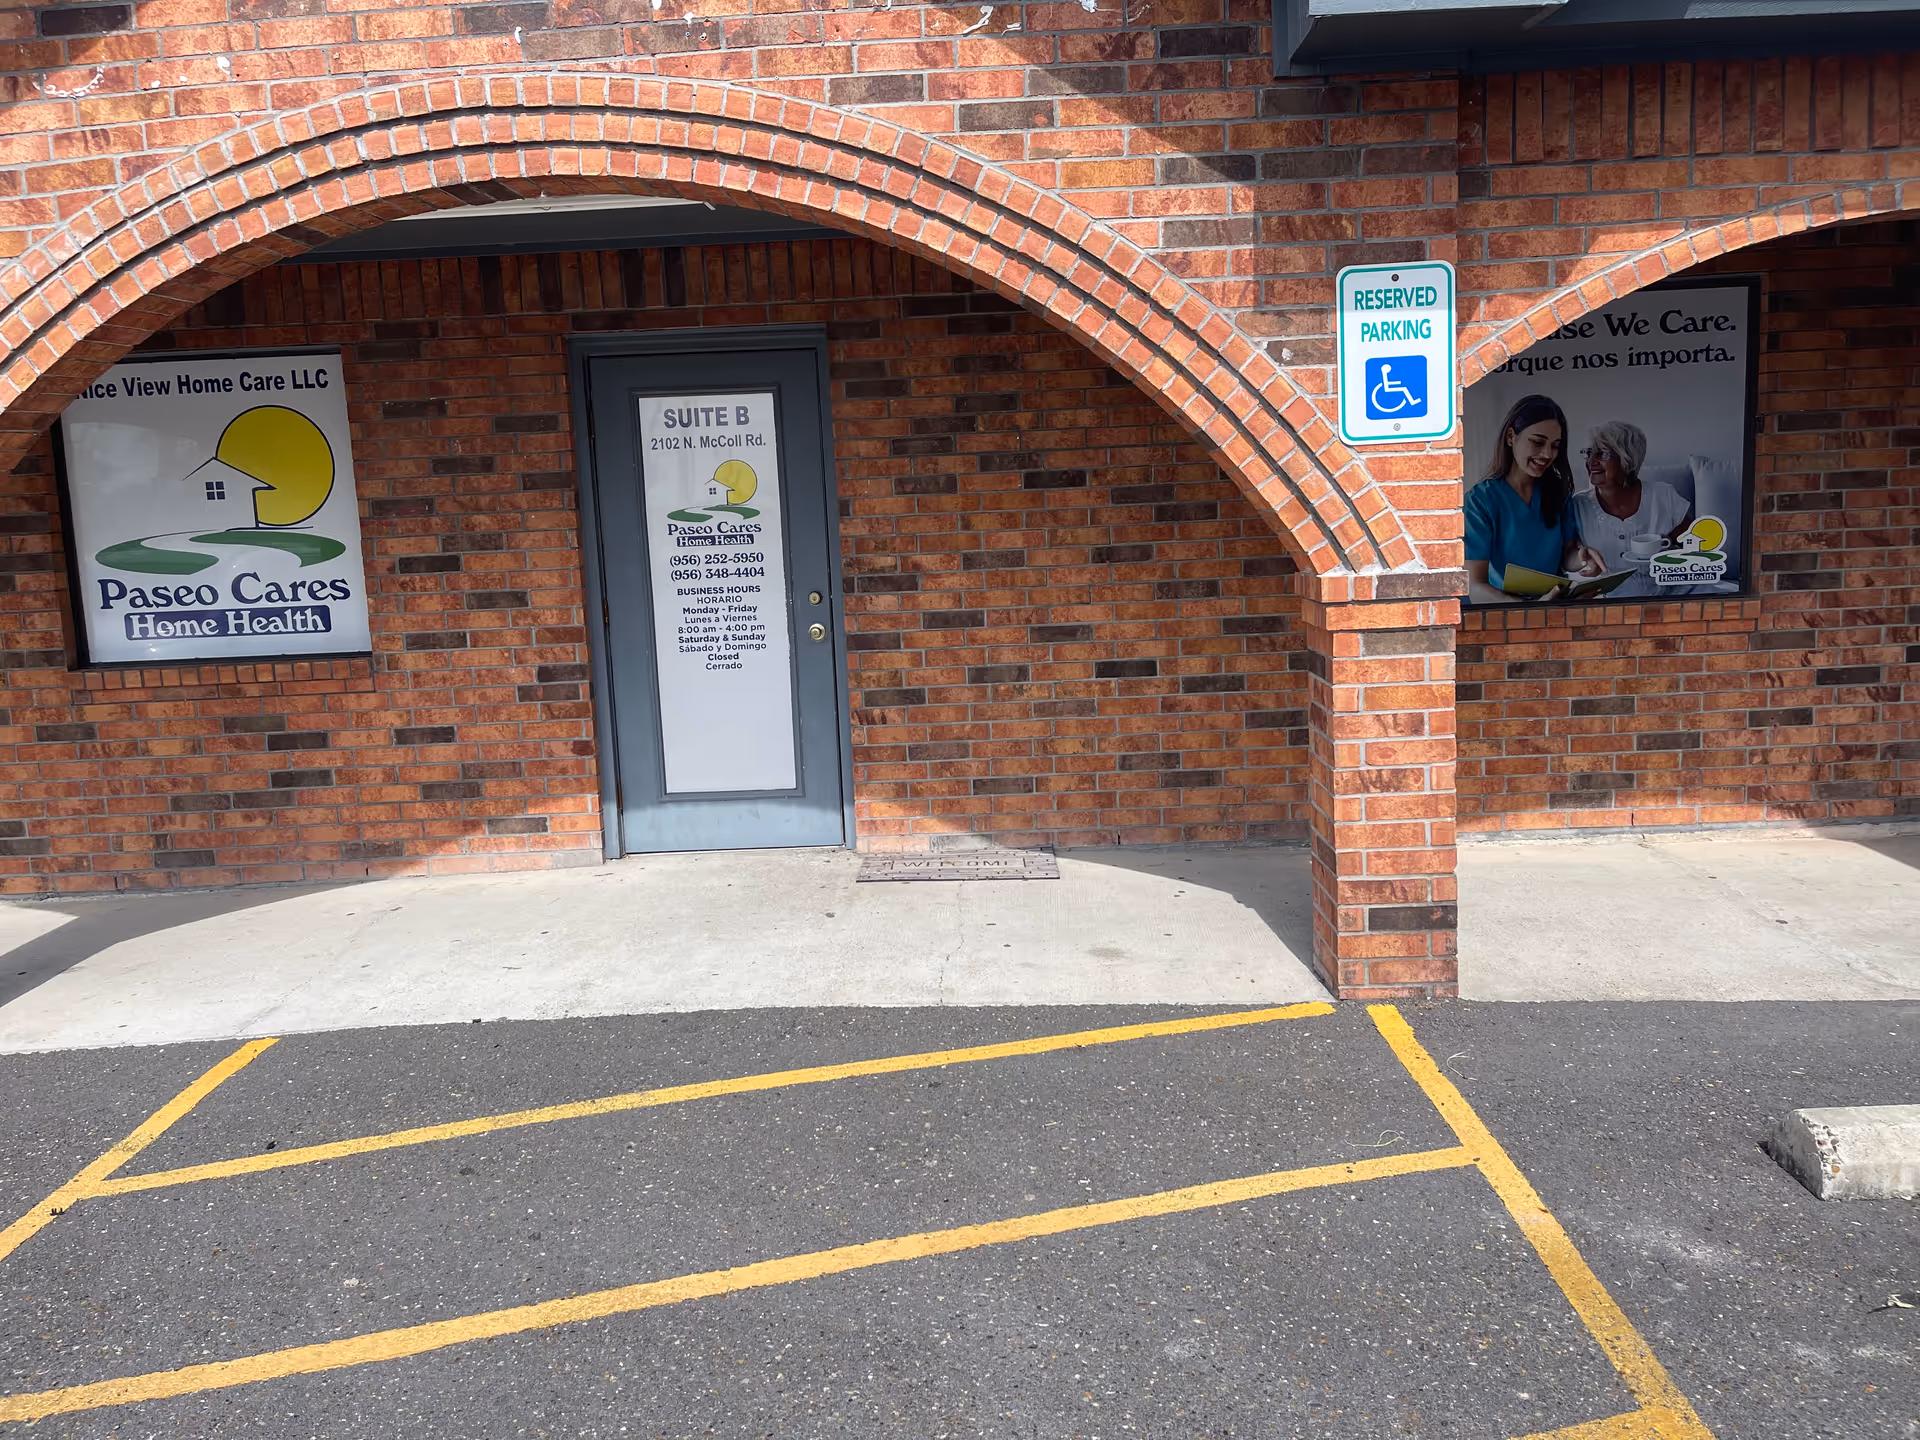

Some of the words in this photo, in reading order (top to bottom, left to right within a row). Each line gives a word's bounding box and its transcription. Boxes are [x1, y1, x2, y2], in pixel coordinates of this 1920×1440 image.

[1354, 286, 1437, 310] RESERVED
[1361, 318, 1432, 342] PARKING
[1603, 312, 1650, 337] We
[1659, 309, 1736, 333] Care.
[1572, 352, 1618, 370] nos
[1627, 344, 1735, 370] importa.
[121, 377, 170, 396] View
[176, 374, 233, 395] Home
[239, 371, 285, 391] Care
[291, 368, 329, 389] LLC
[664, 406, 728, 429] SUITE
[735, 405, 750, 426] B
[650, 437, 680, 450] 2102
[683, 436, 696, 449] N.
[700, 434, 742, 449] McColl
[745, 433, 766, 447] Rd.
[667, 523, 713, 536] Paseo
[716, 521, 762, 534] Cares
[678, 536, 713, 547] Home
[714, 534, 752, 545] Health
[670, 554, 701, 567] (956)
[704, 552, 764, 565] 252-5950
[671, 569, 702, 582] (956)
[705, 567, 765, 579] 348-4404
[1653, 564, 1686, 574] Paseo
[1690, 563, 1723, 573] Cares
[1660, 574, 1686, 582] Home
[1687, 573, 1715, 581] Health
[97, 577, 219, 610] Paseo
[231, 571, 351, 604] Cares
[677, 586, 724, 596] BUSINESS
[727, 585, 761, 594] HOURS
[696, 595, 743, 605] HORARIO
[682, 606, 719, 615] Monday
[728, 605, 758, 613] Friday
[128, 614, 219, 638] Home
[225, 607, 326, 635] Health
[684, 615, 712, 624] Lunes
[723, 614, 757, 622] Viernes
[678, 626, 699, 634] 8:00
[725, 624, 748, 632] 4:00
[750, 624, 765, 632] pm
[678, 635, 720, 644] Saturday
[723, 634, 729, 642] &
[731, 633, 766, 642] Sunday
[679, 644, 713, 653] Sábado
[725, 642, 767, 651] Domingo
[708, 652, 740, 661] Closed
[705, 662, 743, 670] Cerrado
